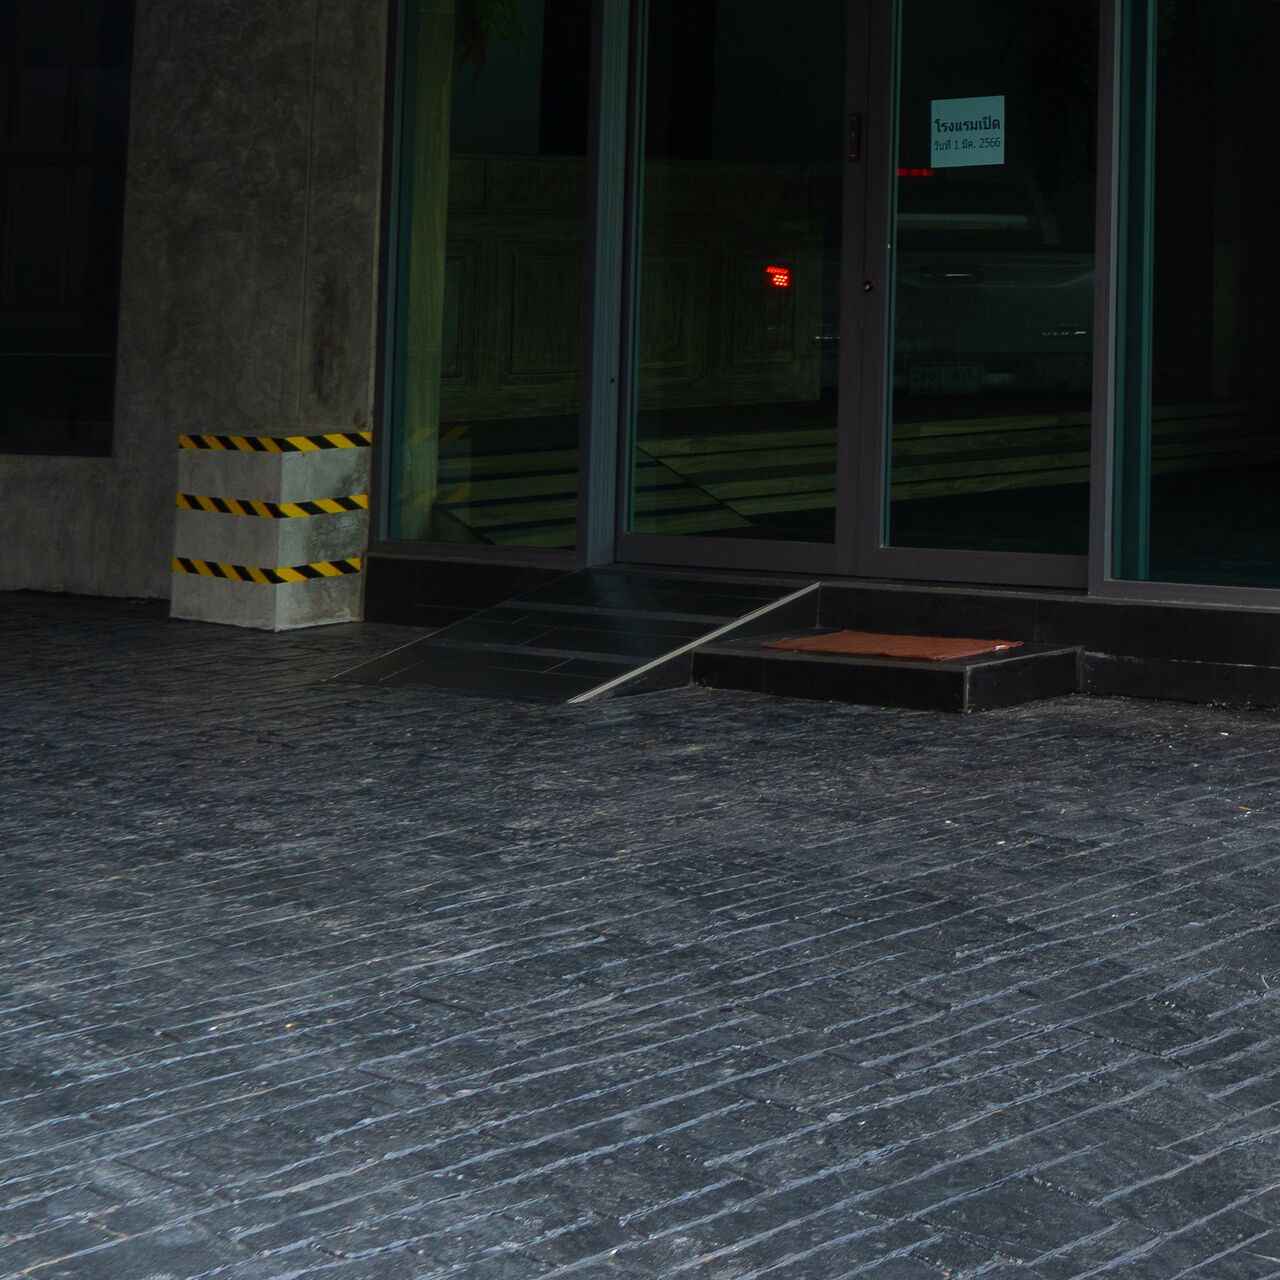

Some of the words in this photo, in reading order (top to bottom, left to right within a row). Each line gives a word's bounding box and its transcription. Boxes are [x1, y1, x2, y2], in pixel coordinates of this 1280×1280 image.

[934, 115, 1001, 133] โรงแรมเปิด
[979, 137, 1001, 148] 2566
